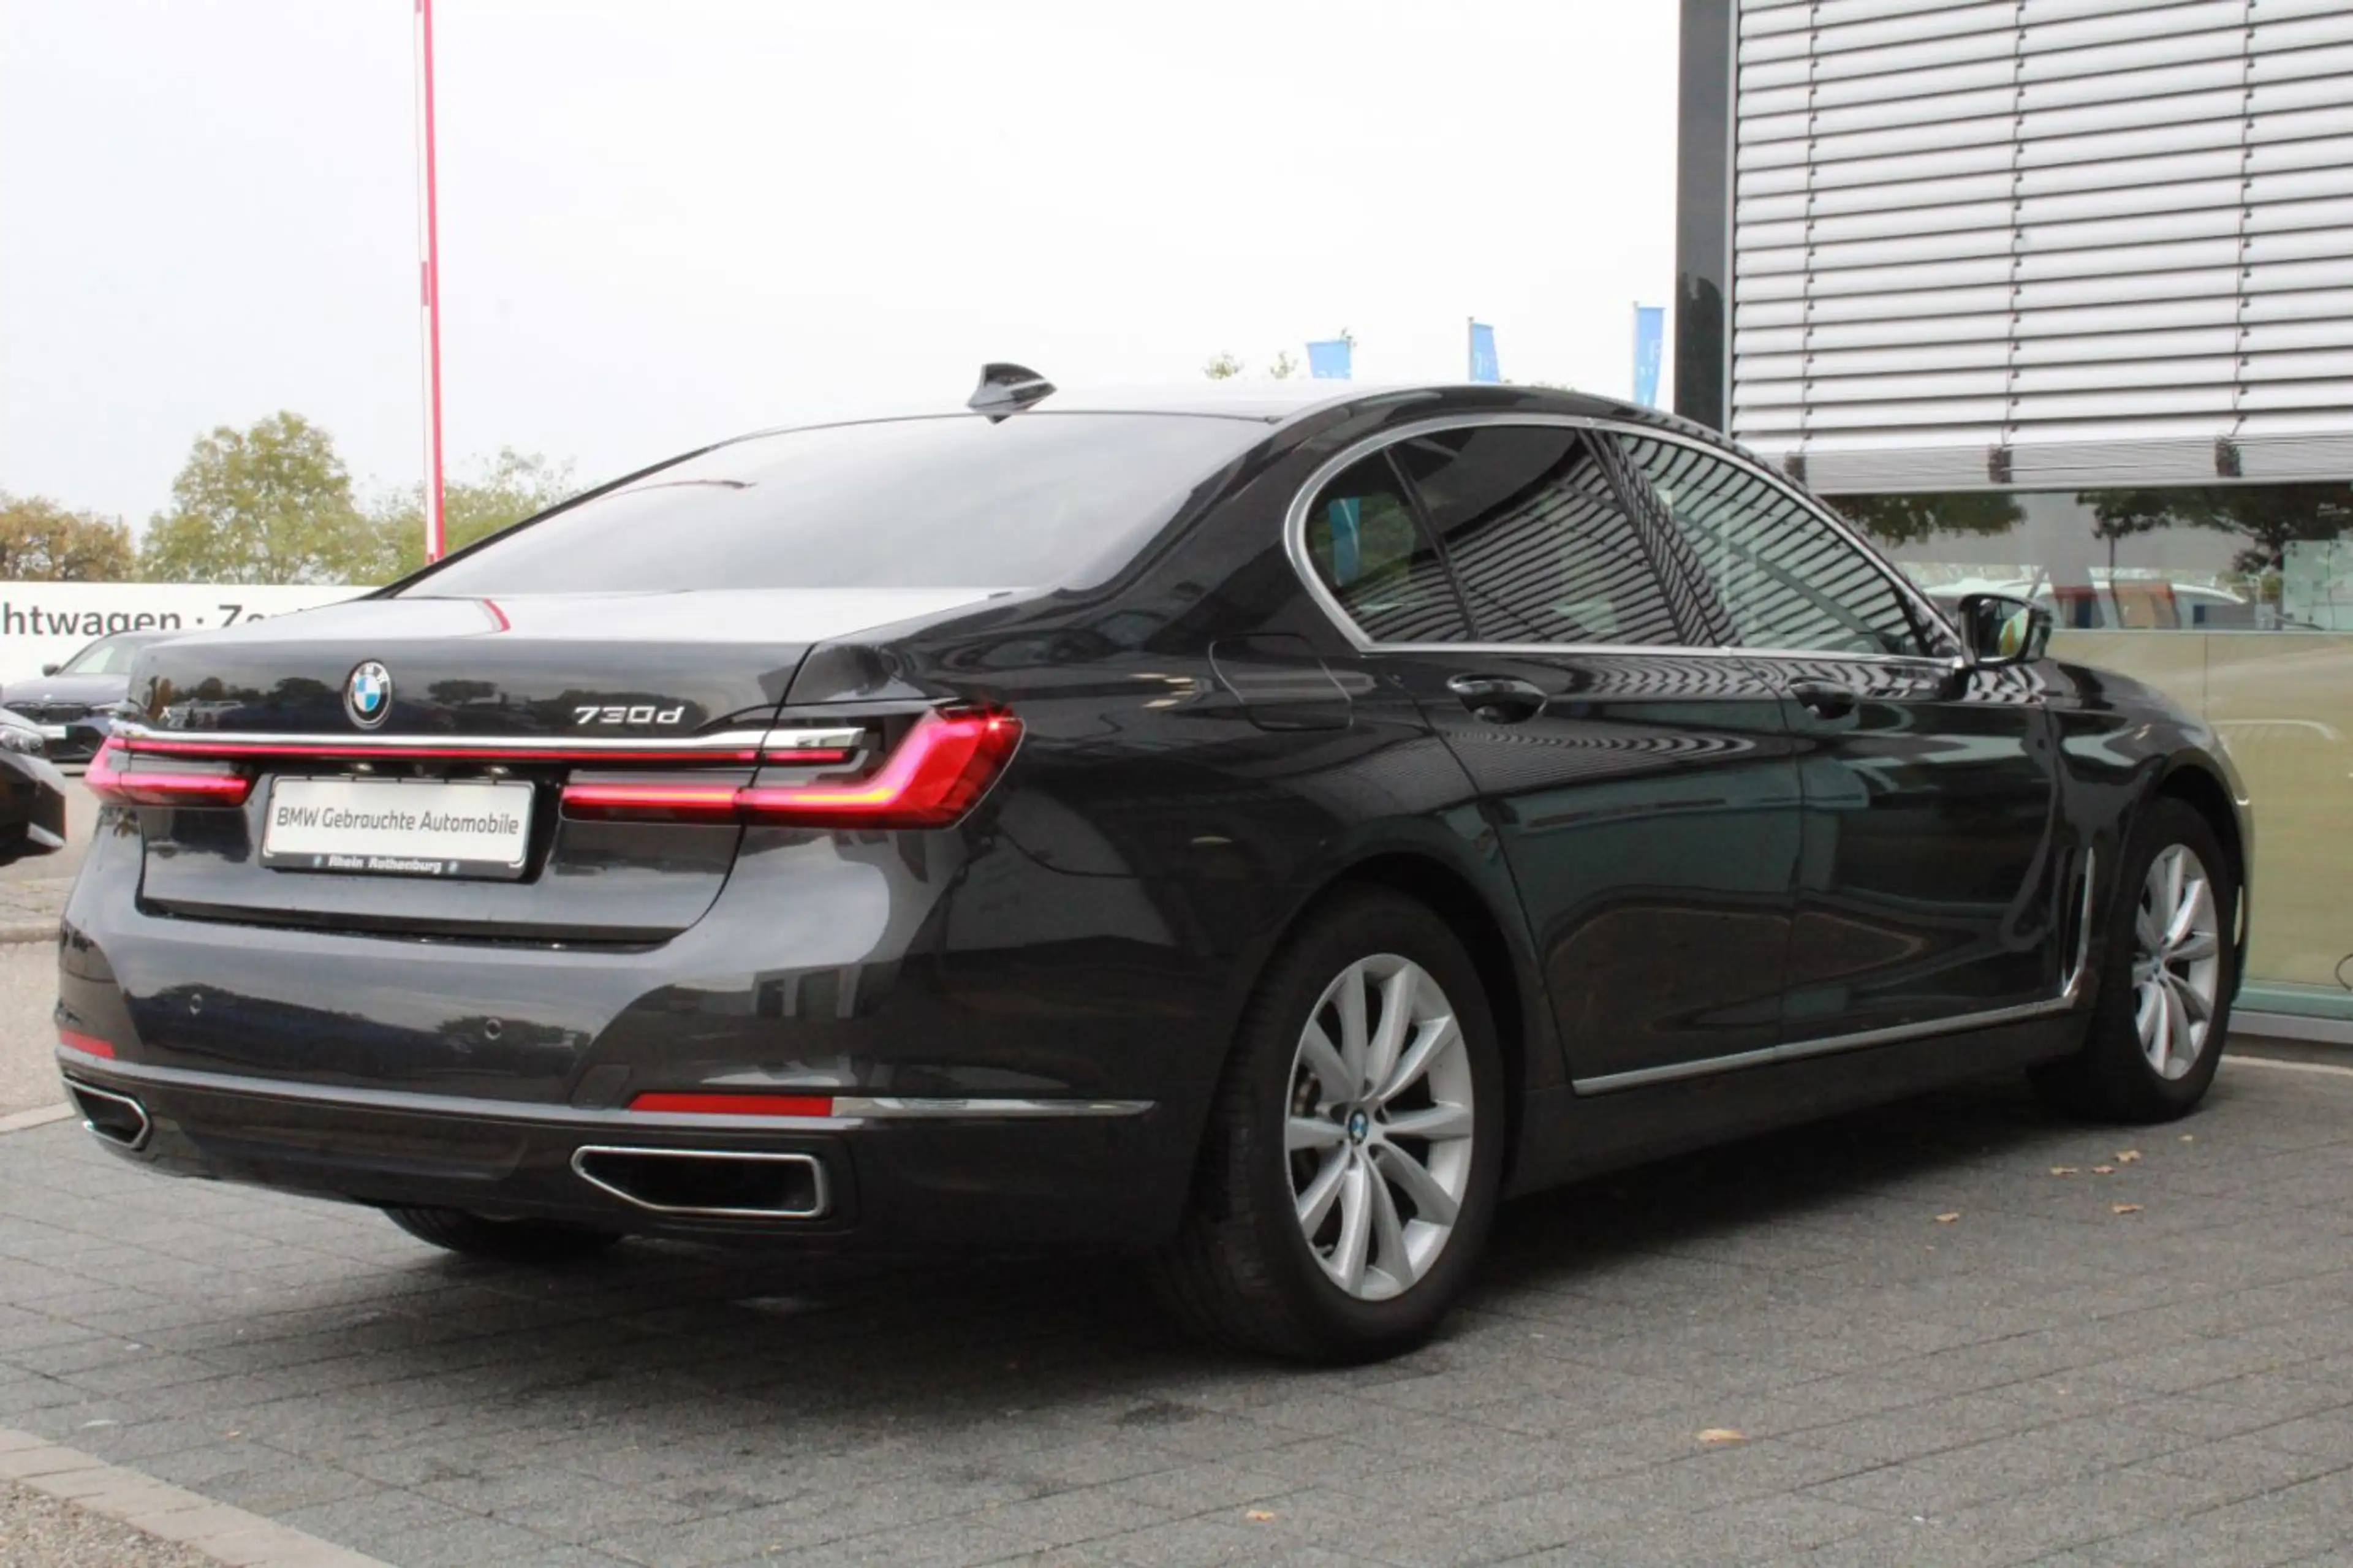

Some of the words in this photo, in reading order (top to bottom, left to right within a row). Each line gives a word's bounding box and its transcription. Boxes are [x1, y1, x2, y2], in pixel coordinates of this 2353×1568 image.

[574, 705, 685, 725] 730d
[277, 806, 320, 827] BMW
[322, 806, 416, 831] Gebrauchte
[420, 809, 519, 835] Automobile
